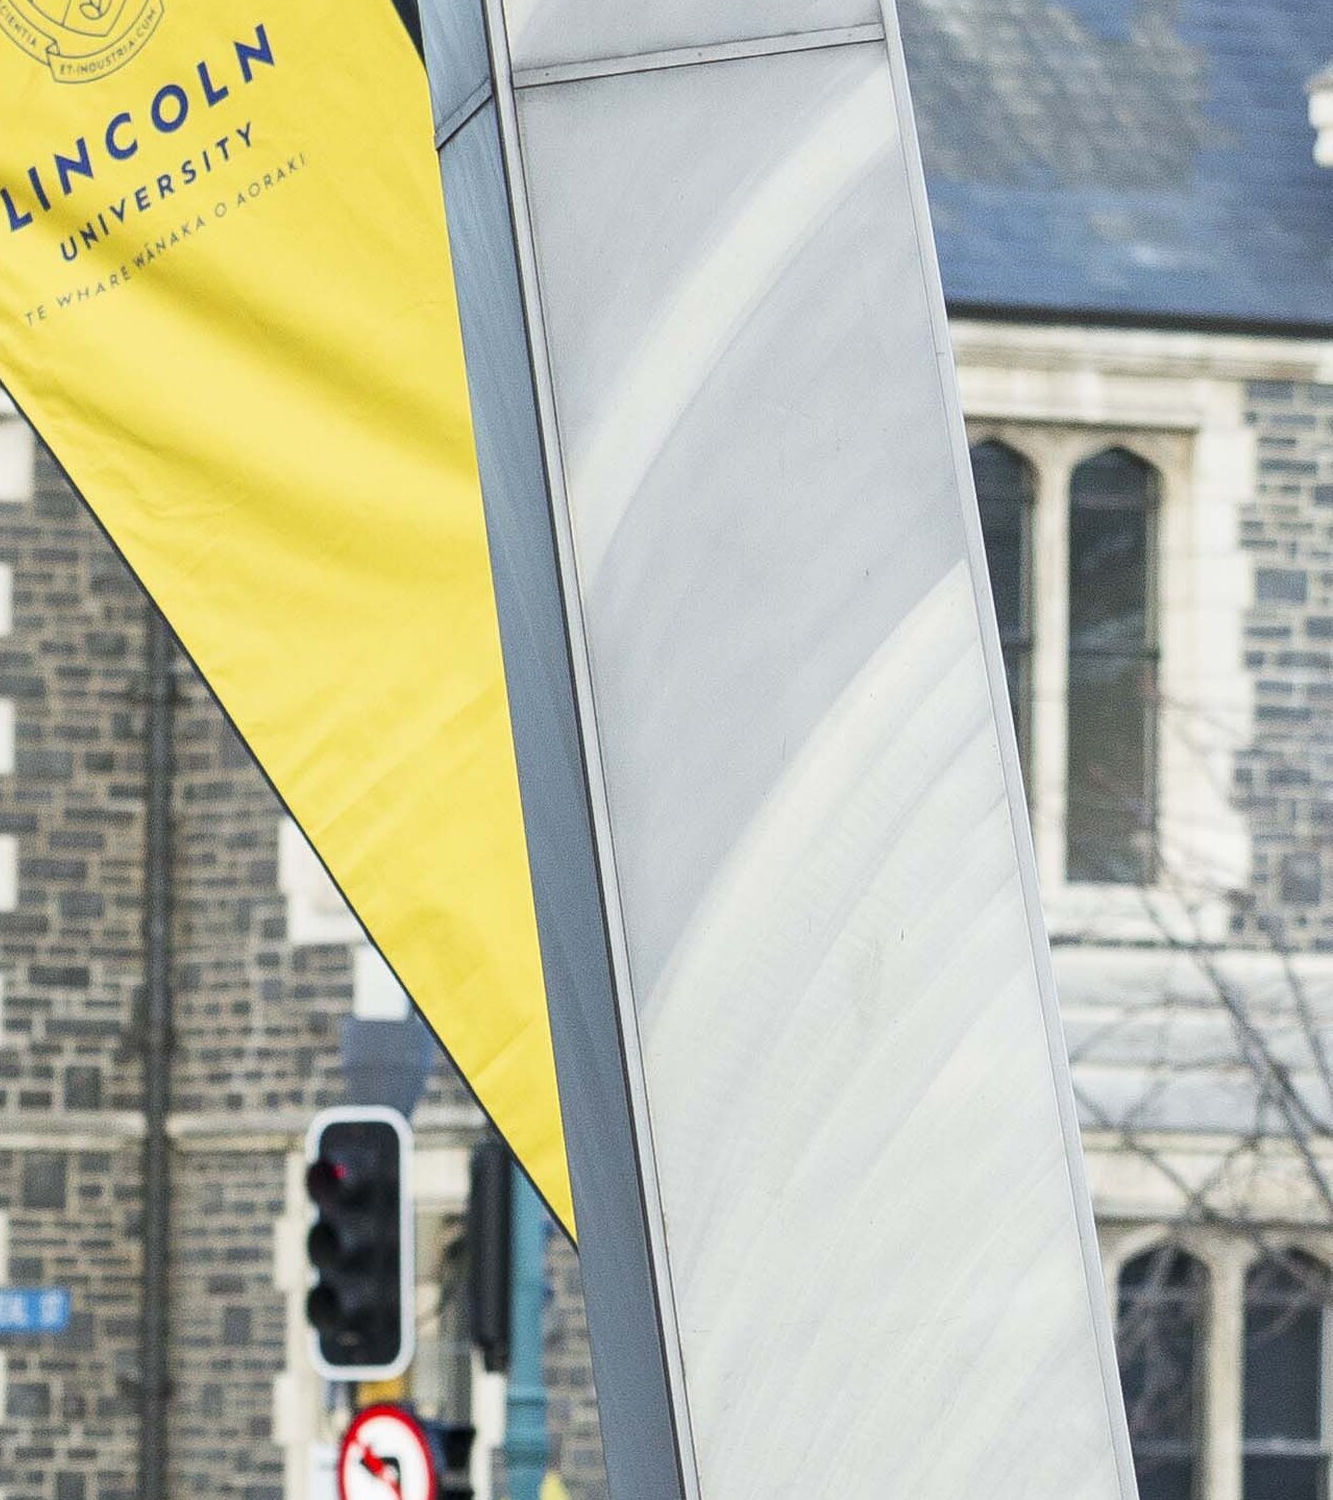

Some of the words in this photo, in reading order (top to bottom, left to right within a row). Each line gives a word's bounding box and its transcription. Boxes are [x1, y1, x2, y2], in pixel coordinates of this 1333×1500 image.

[0, 23, 275, 233] LINCOLN
[60, 121, 252, 262] UNIVERSITY
[24, 305, 47, 327] TE
[57, 265, 131, 308] WHARE
[214, 202, 228, 218] O
[236, 152, 307, 209] AORAKI
